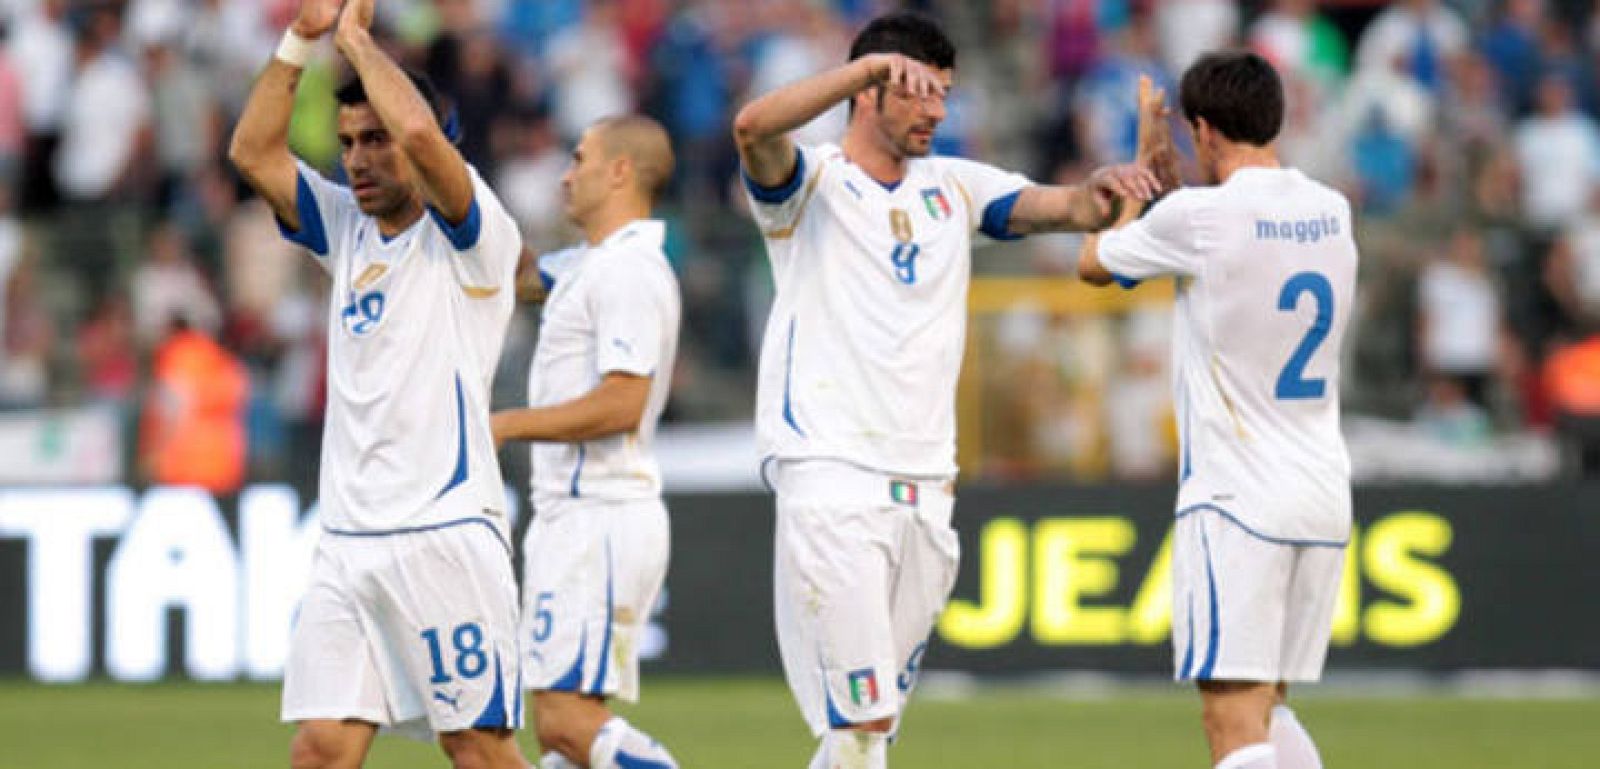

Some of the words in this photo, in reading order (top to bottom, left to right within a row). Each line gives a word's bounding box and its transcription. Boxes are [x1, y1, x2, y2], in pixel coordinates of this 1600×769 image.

[1275, 270, 1334, 399] 2
[532, 592, 554, 642] 5
[938, 512, 1461, 648] JES
[420, 622, 487, 683] 18
